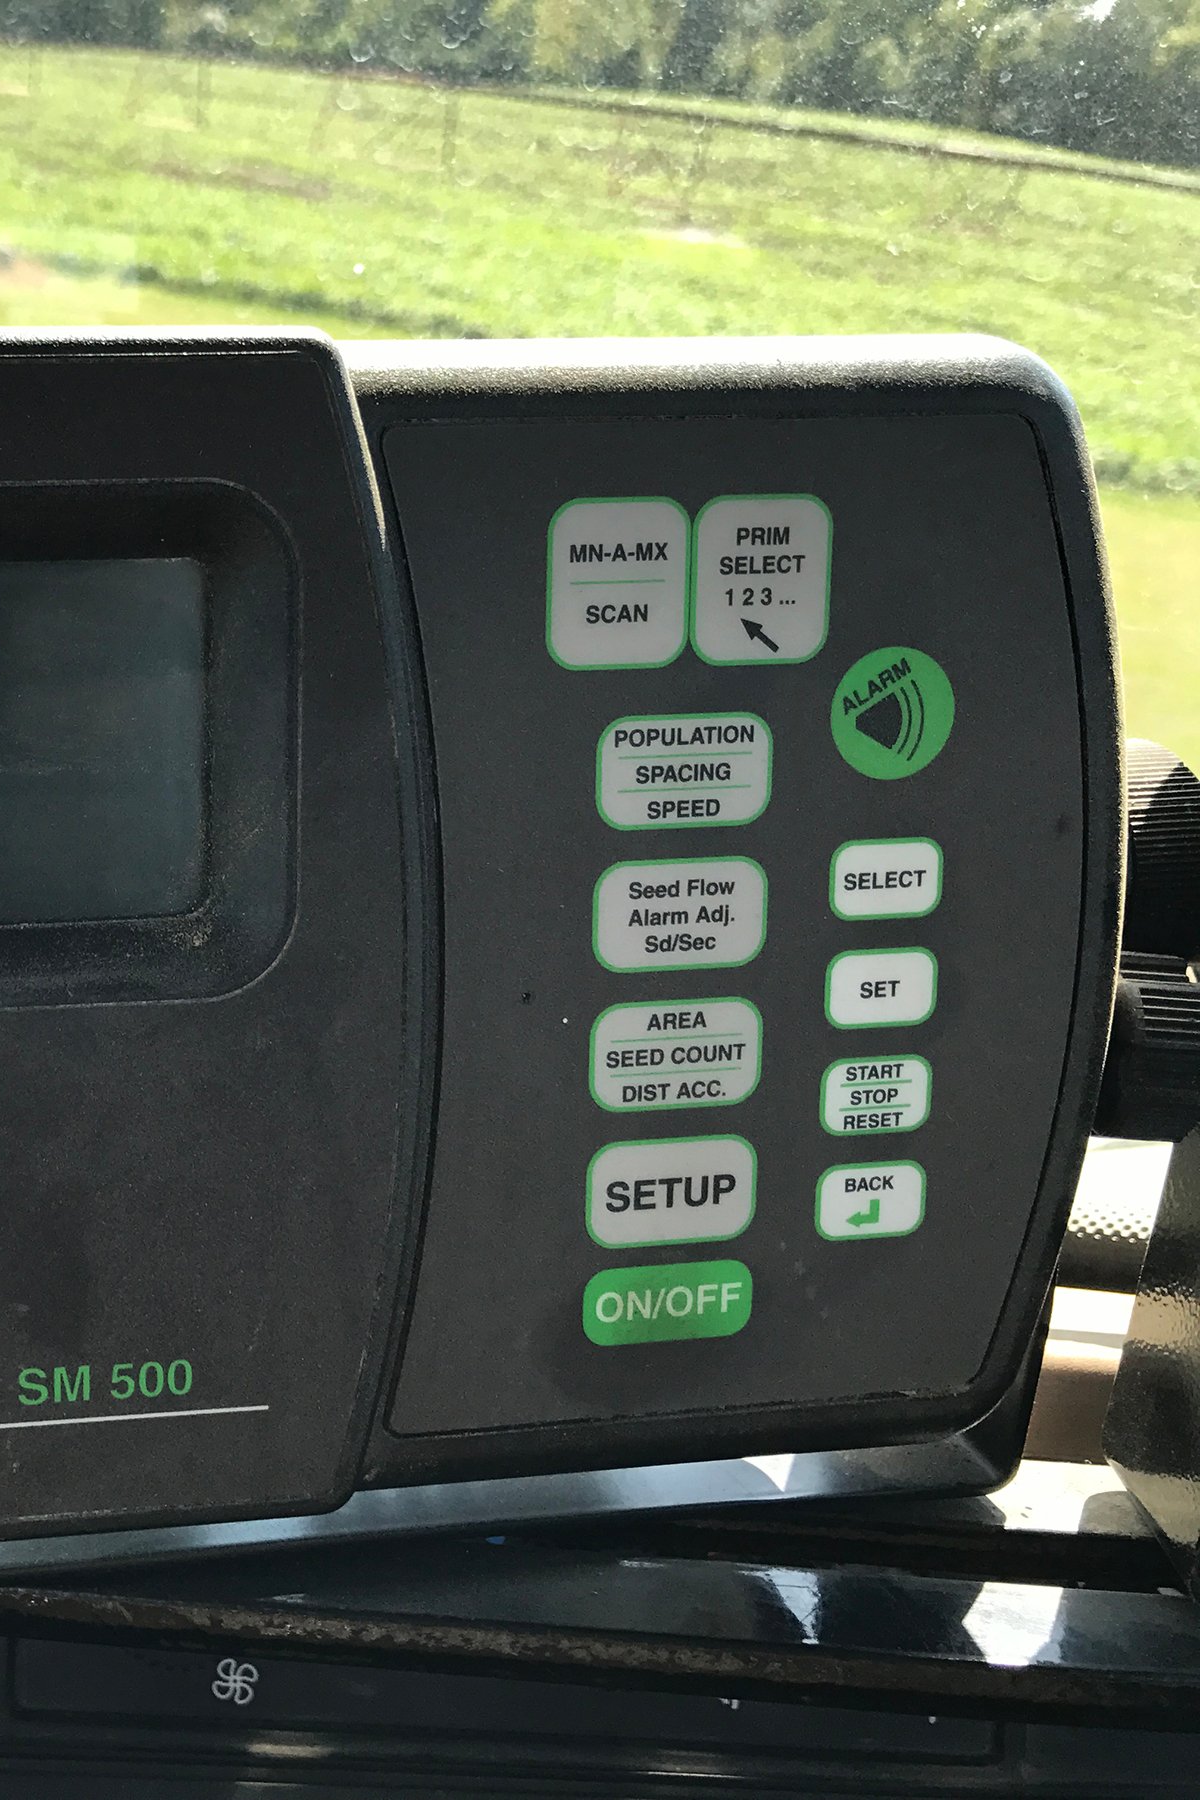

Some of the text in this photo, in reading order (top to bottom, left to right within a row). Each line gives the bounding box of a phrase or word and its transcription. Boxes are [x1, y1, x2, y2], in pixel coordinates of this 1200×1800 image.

[736, 526, 790, 546] PRIM
[569, 542, 668, 563] MN-A-MX
[719, 554, 806, 576] SELECT
[725, 588, 734, 606] 1
[742, 587, 755, 606] 2
[760, 587, 773, 606] 3
[585, 603, 649, 624] SCAN
[840, 656, 913, 716] ALARM
[613, 724, 756, 749] POPULATION
[635, 762, 731, 785] SPACING
[647, 798, 721, 820] SPEED
[629, 878, 735, 900] Seed Flow
[843, 869, 927, 891] SELECT
[628, 904, 735, 927] Alarm Adj.
[644, 933, 716, 954] Sd/Sec
[860, 980, 901, 999] SET
[646, 1011, 707, 1031] AREA
[606, 1043, 746, 1069] SEED COUNT
[845, 1063, 904, 1082] START
[622, 1079, 726, 1103] DIST ACC.
[850, 1087, 899, 1106] STOP
[843, 1111, 904, 1130] RESET
[605, 1173, 737, 1213] SETUP
[844, 1175, 894, 1193] BACK
[595, 1281, 743, 1324] ON/OFF
[17, 1359, 193, 1406] SM 500
